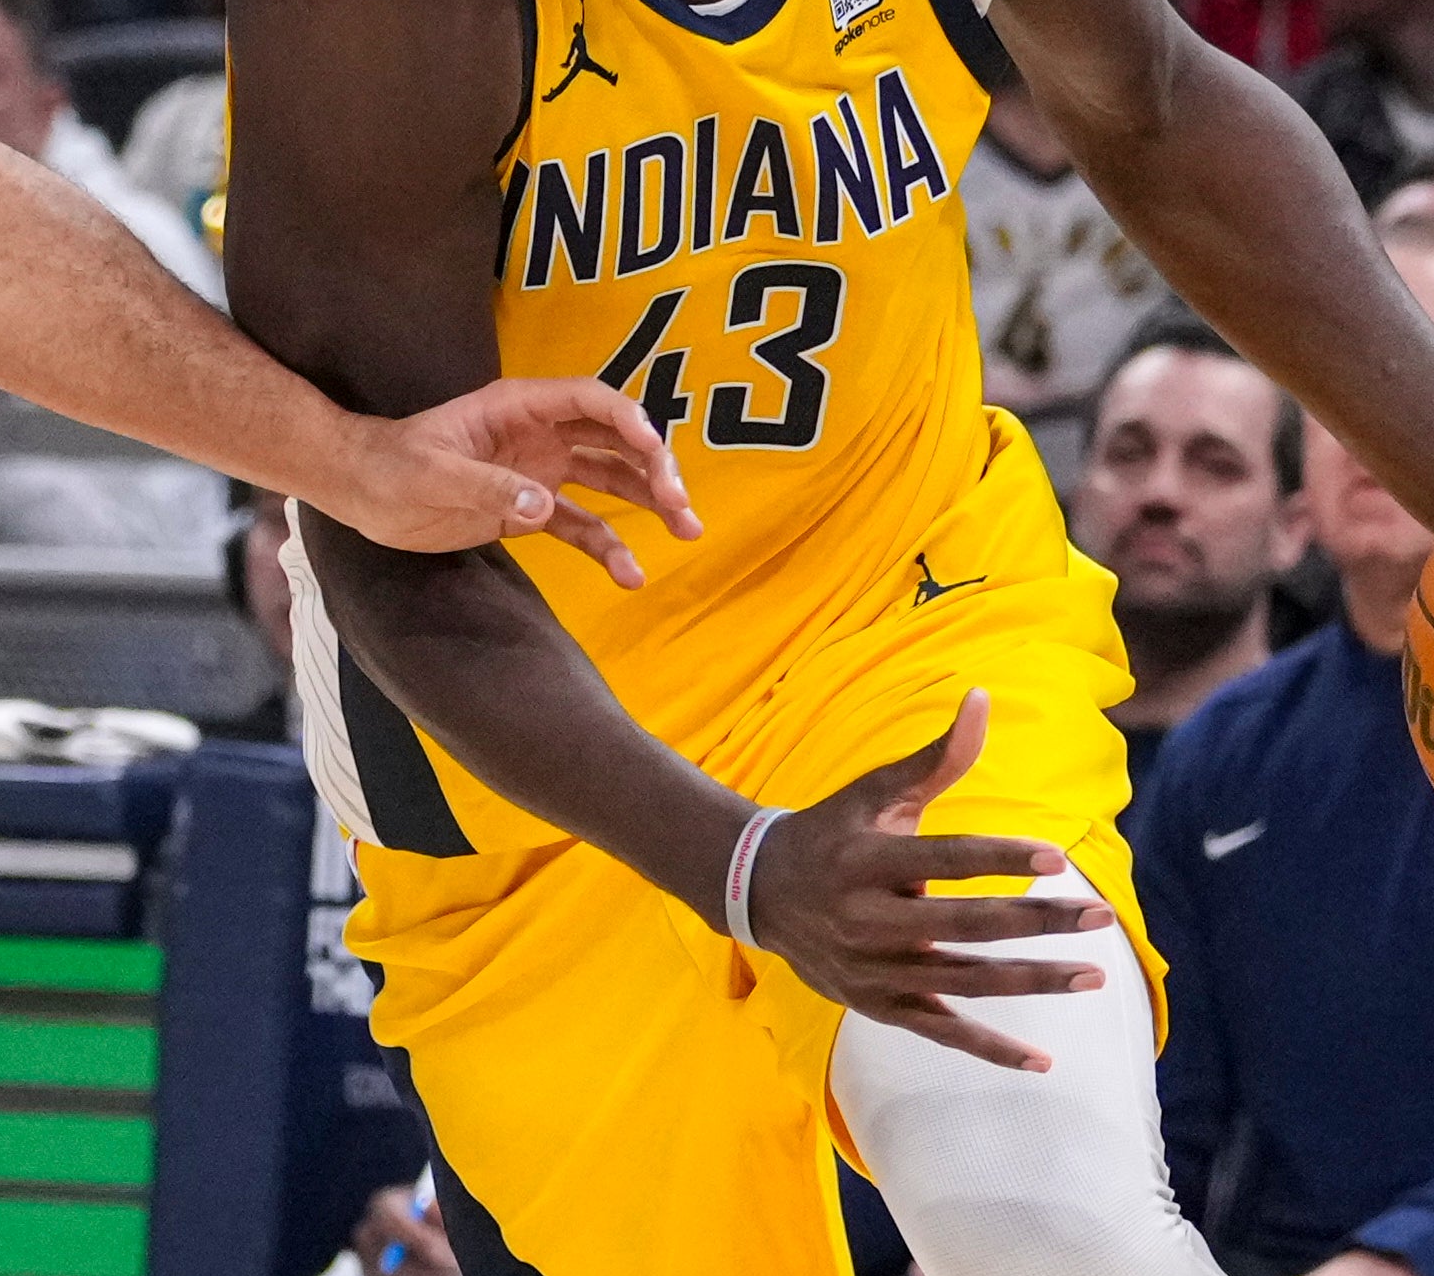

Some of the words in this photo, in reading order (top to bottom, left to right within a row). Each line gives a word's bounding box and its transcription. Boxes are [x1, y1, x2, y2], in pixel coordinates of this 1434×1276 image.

[834, 8, 895, 57] spokenote
[493, 66, 951, 291] INDIANA
[596, 259, 848, 452] 43
